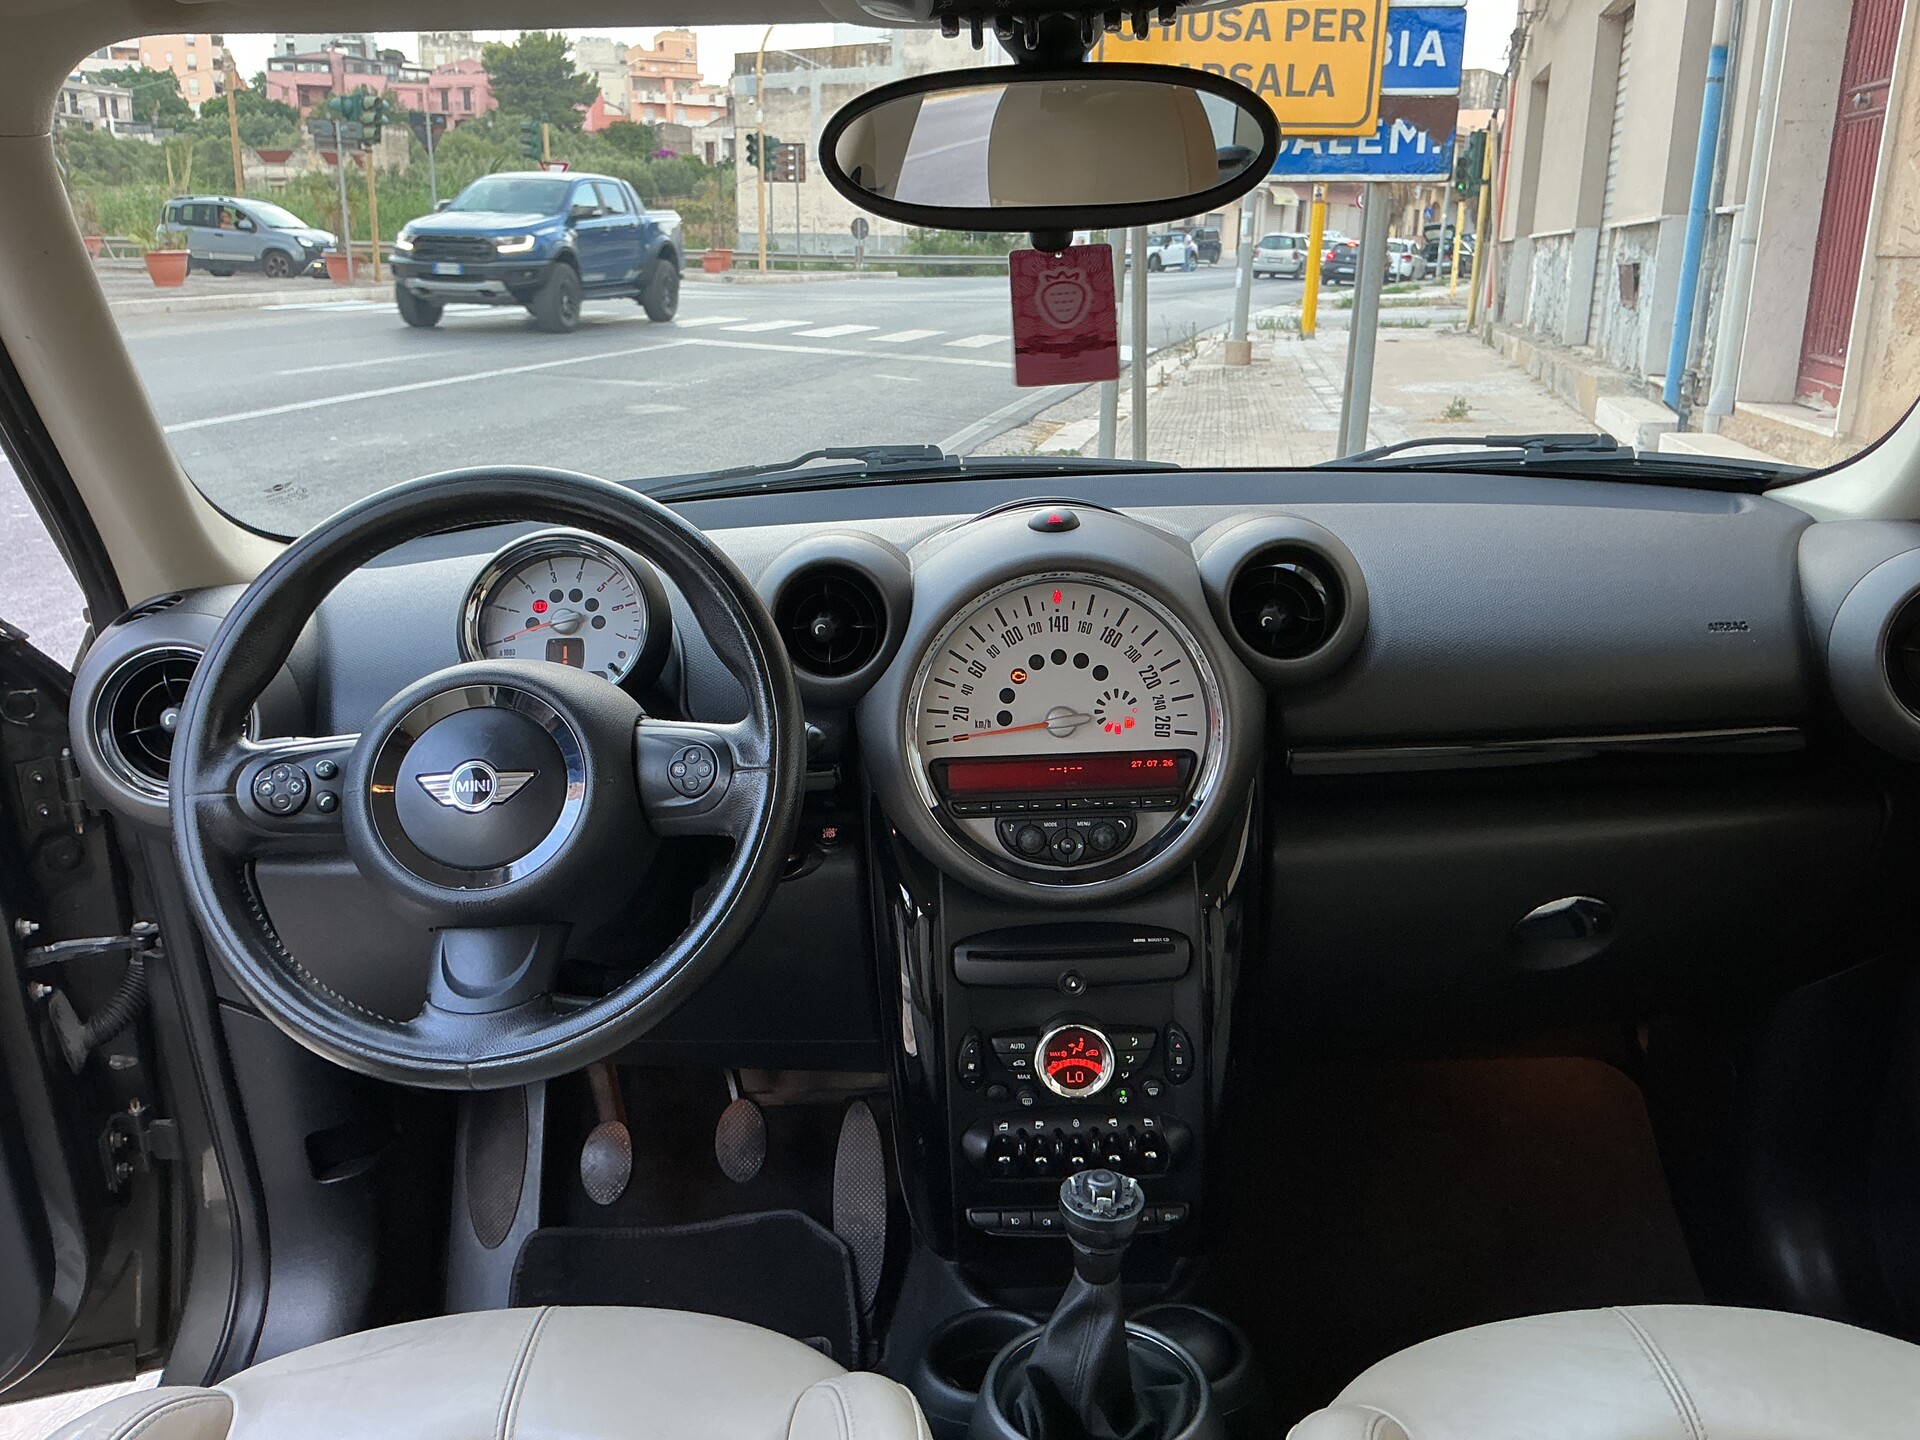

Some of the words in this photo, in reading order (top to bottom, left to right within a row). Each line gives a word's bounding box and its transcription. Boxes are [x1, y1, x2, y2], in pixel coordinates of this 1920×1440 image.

[1285, 9, 1366, 42] PER
[550, 571, 557, 583] 3
[576, 571, 583, 583] 4
[525, 584, 536, 595] 2
[597, 582, 607, 592] 5
[1027, 621, 1042, 636] 120
[1048, 616, 1069, 632] 140
[1077, 620, 1093, 634] 160
[1001, 626, 1024, 648] 100
[1100, 626, 1123, 648] 180
[986, 644, 1001, 659] 80
[1123, 645, 1142, 664] 200
[968, 659, 987, 679] 60
[1138, 664, 1162, 690] 220
[961, 683, 974, 696] 40
[1152, 694, 1167, 711] 240
[953, 706, 969, 722] 20
[974, 718, 992, 729] km/h
[1154, 715, 1171, 738] 260
[1131, 760, 1174, 768] 27.07.26
[456, 779, 491, 793] MINI
[1066, 1071, 1084, 1083] LO
